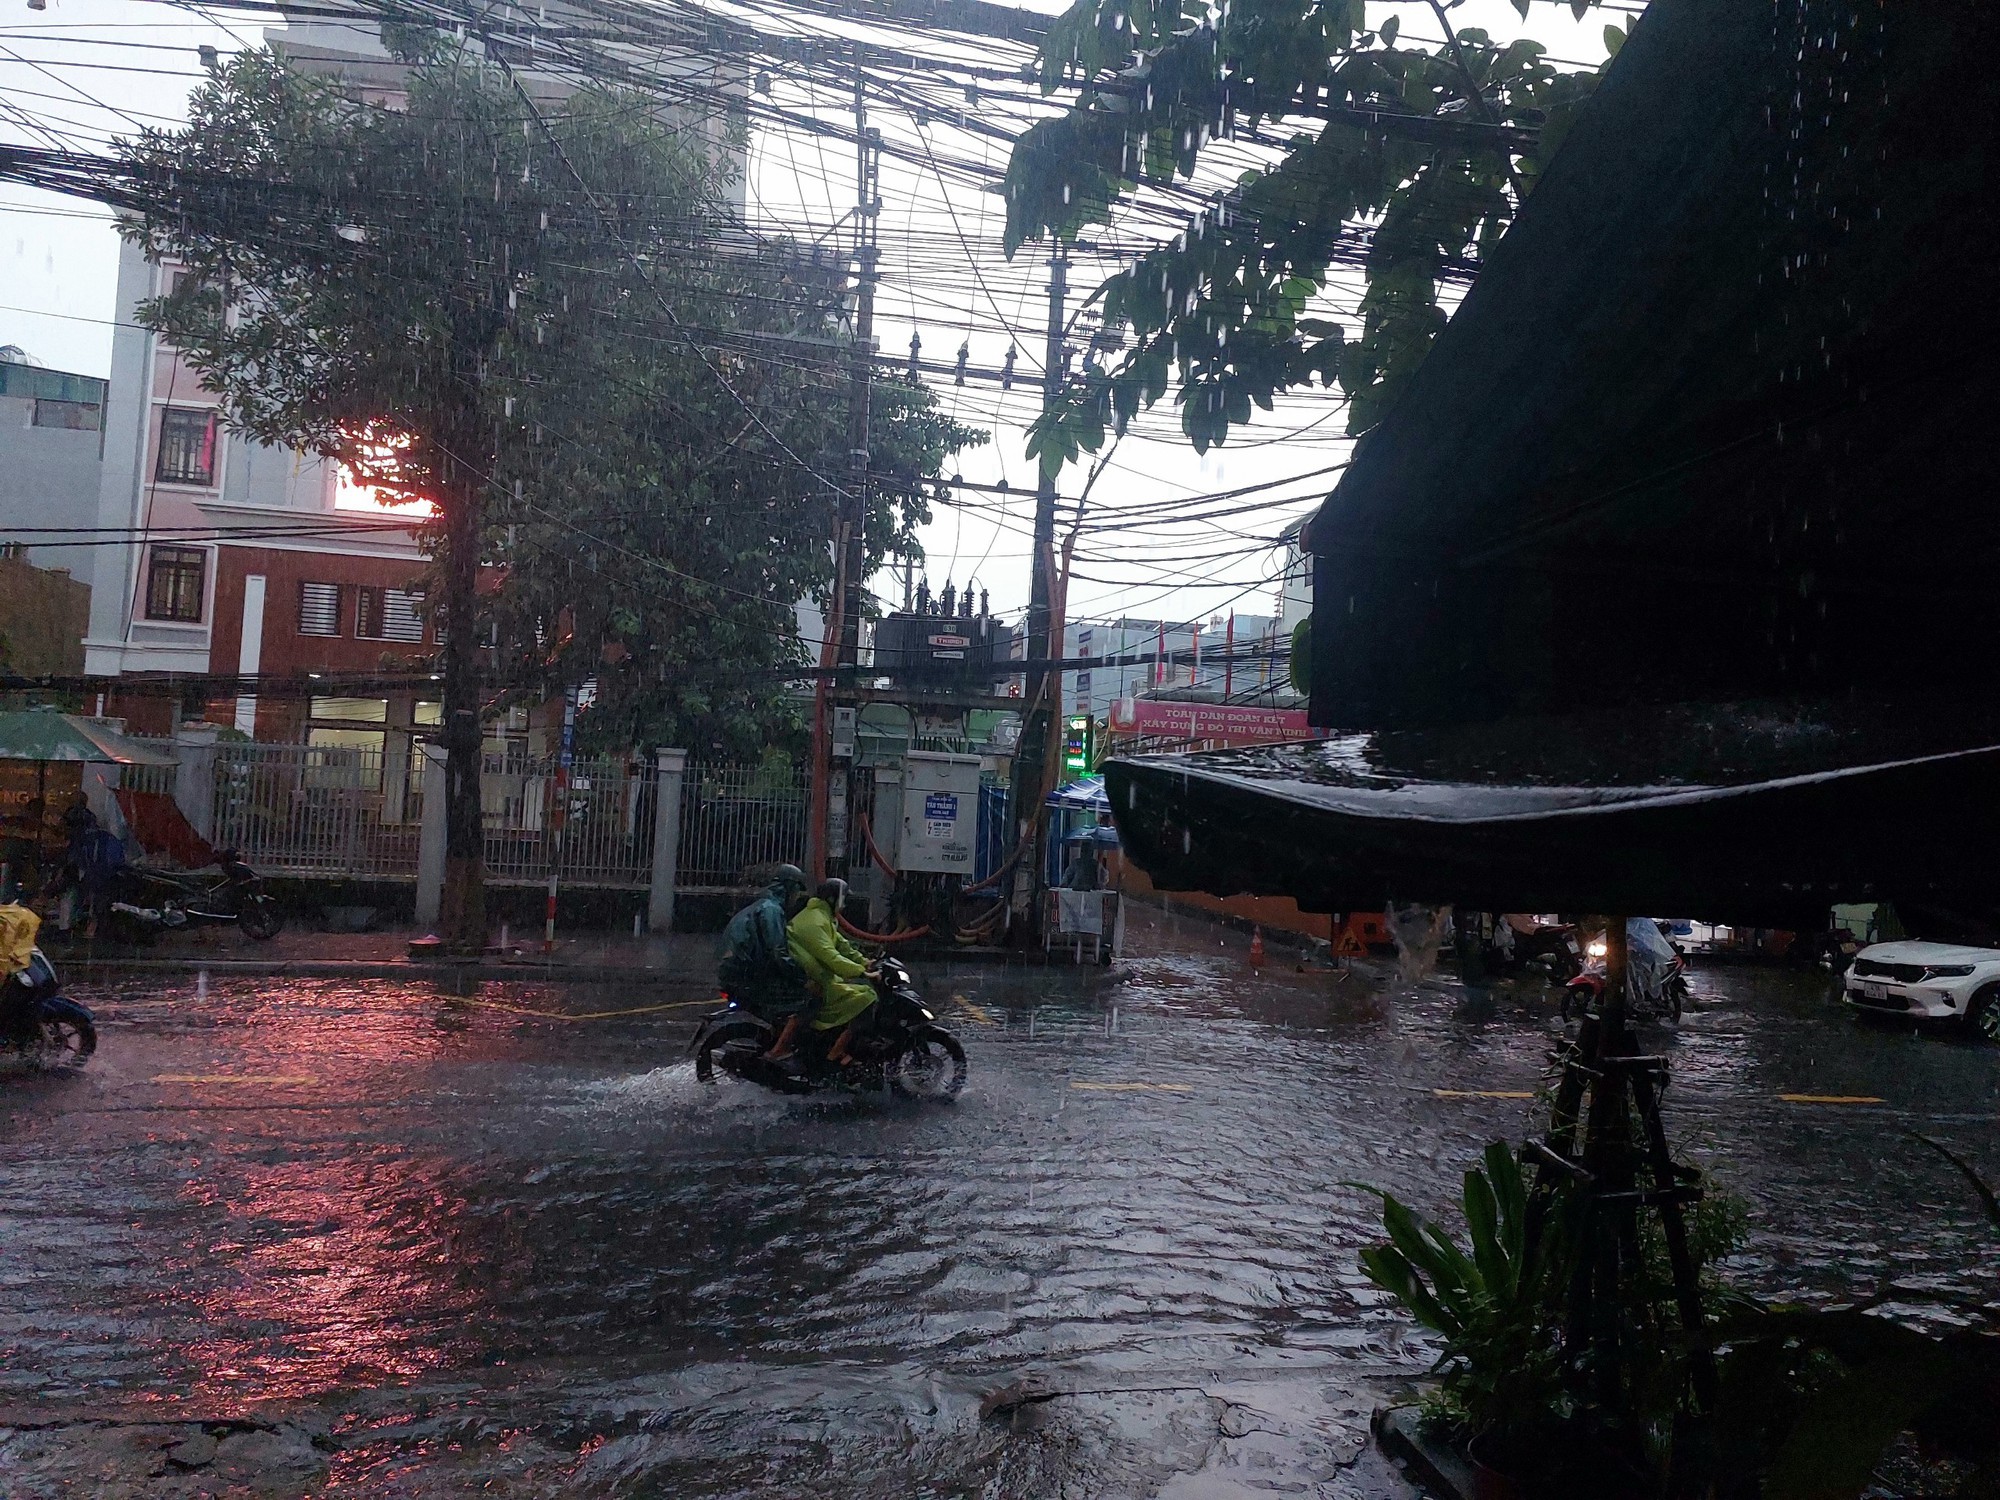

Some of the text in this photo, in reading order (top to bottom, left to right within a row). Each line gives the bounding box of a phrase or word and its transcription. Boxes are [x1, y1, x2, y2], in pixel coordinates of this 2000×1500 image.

[1227, 711, 1261, 723] ĐOÀN
[1263, 713, 1286, 724] KẾT
[1143, 719, 1307, 737] XÂY DỰNG ĐÔ THỊ VĂN MINH
